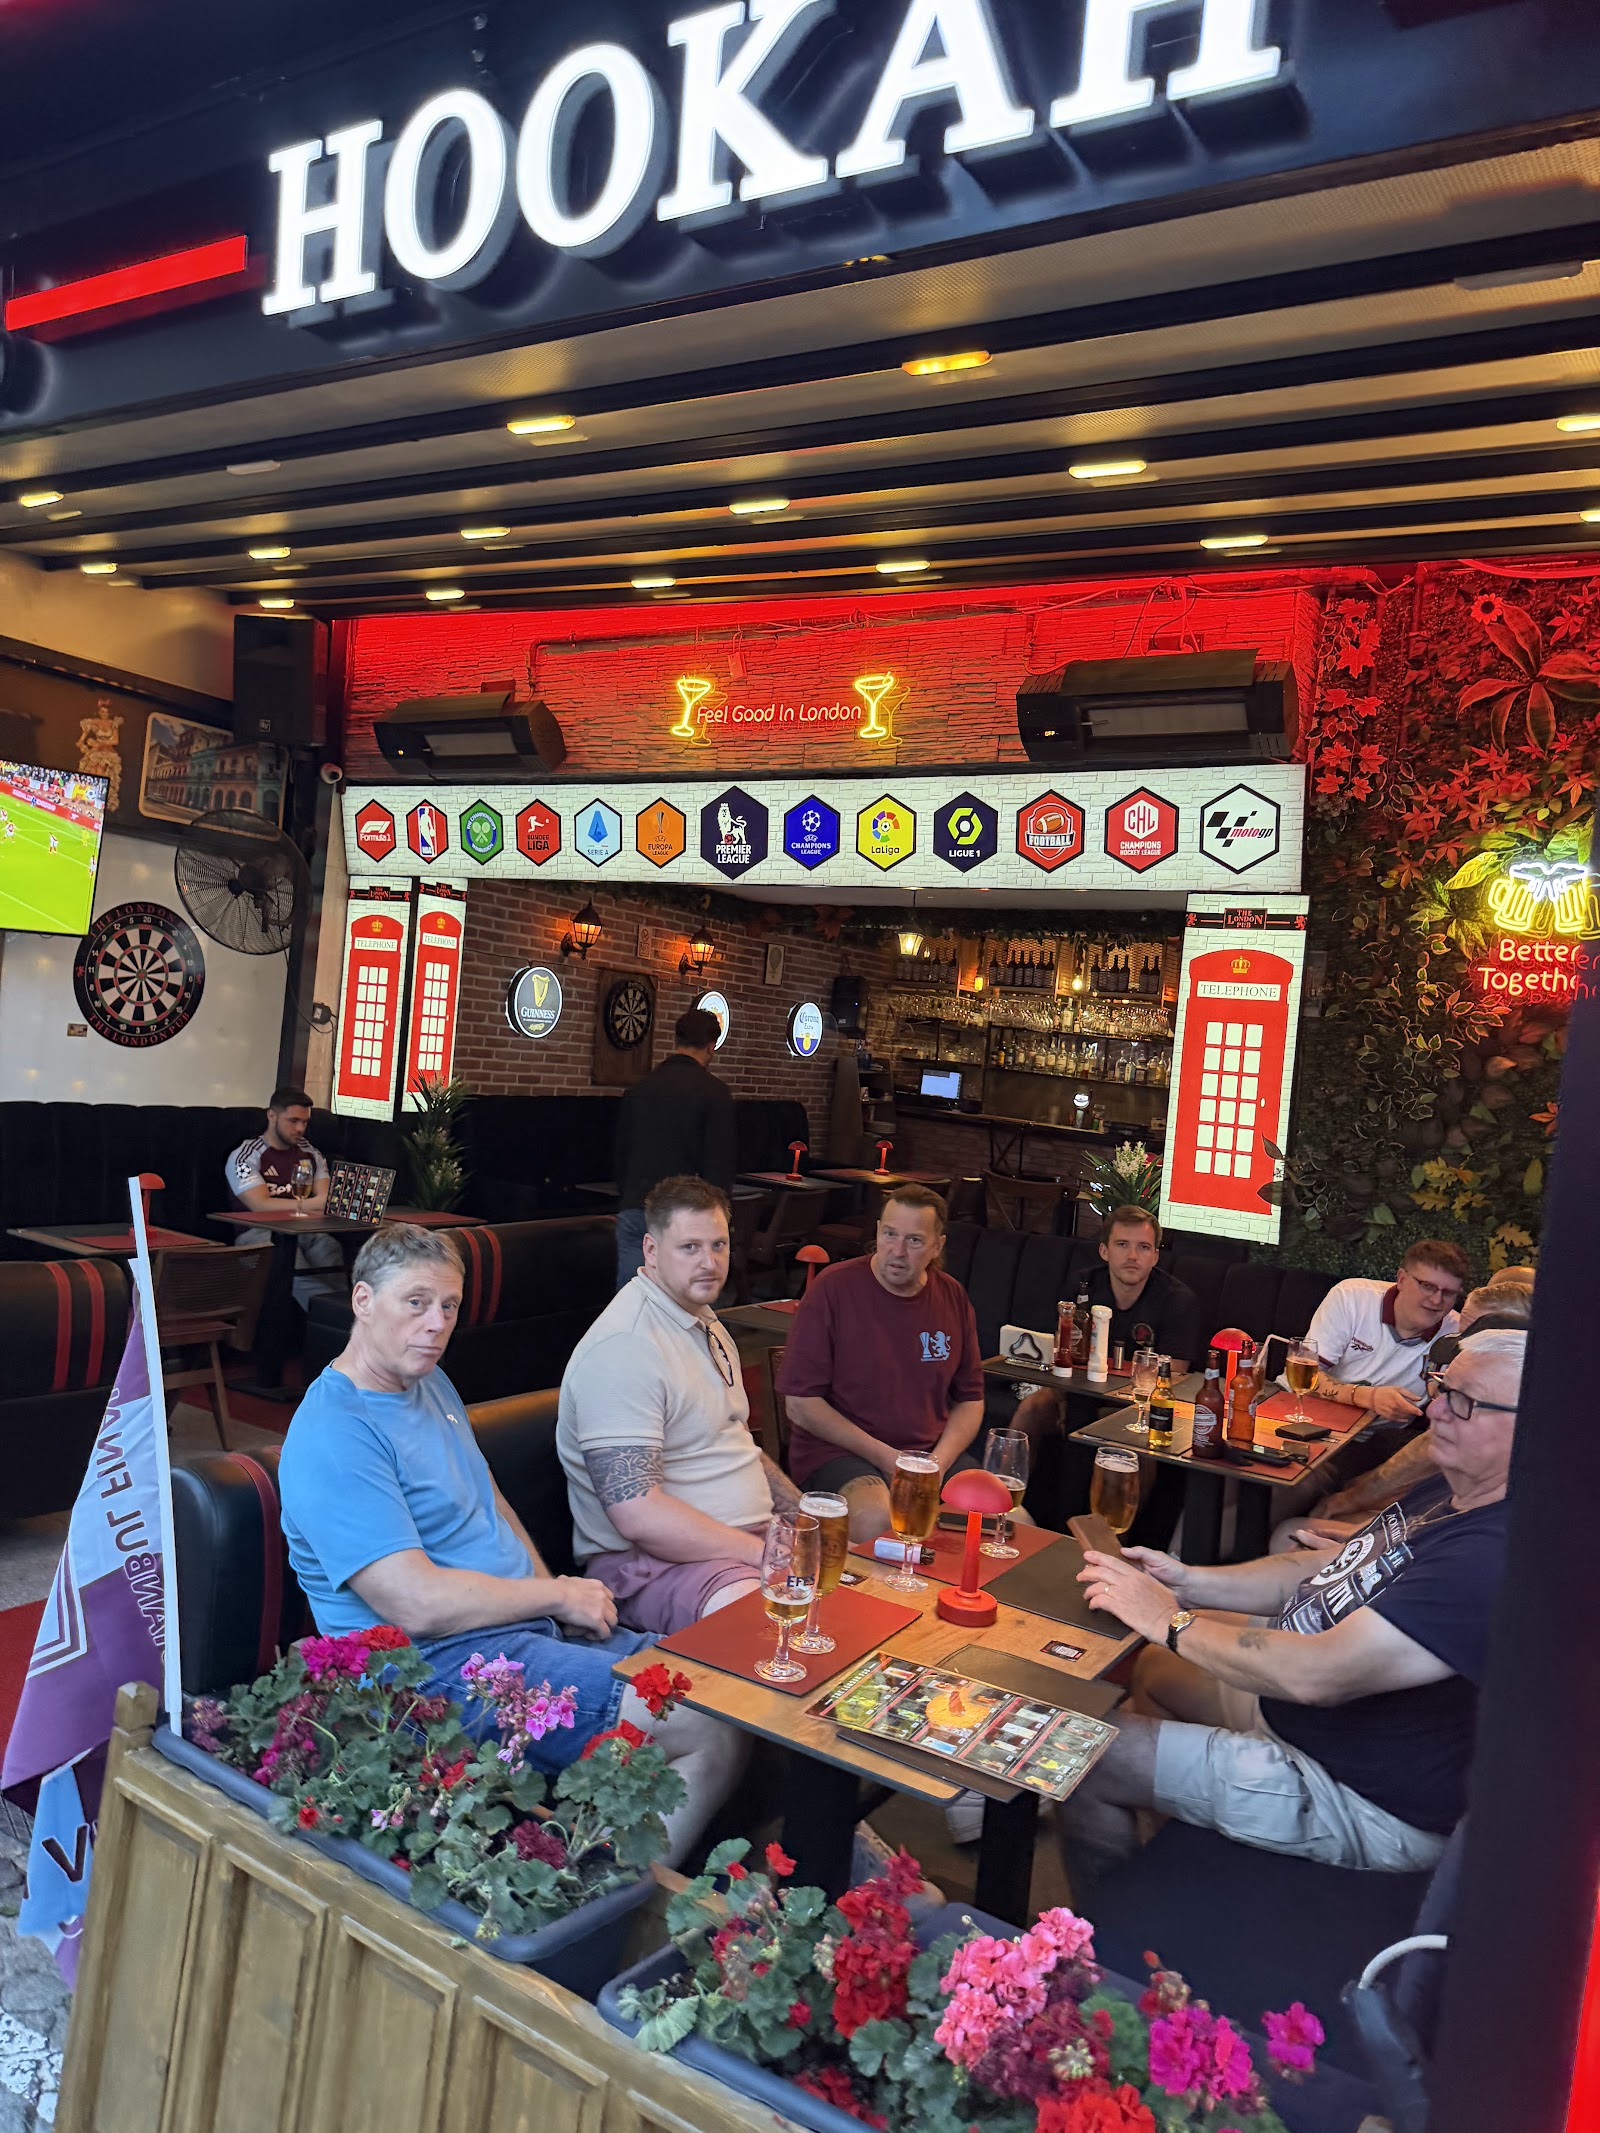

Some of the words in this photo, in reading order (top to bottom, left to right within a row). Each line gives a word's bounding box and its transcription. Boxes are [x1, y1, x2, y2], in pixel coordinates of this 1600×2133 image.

[262, 0, 1282, 316] HOOKAH
[697, 704, 728, 724] Feel
[732, 703, 775, 723] Good
[779, 703, 794, 722] In
[799, 701, 861, 722] London
[1127, 805, 1156, 834] CHL
[1229, 827, 1274, 839] motogp
[527, 840, 550, 851] LIGA
[790, 842, 832, 850] CHAMPIONS
[1028, 834, 1072, 847] FOOTBALL
[1120, 841, 1162, 849] CHAMPIONS
[648, 843, 673, 851] EUROPA
[715, 844, 752, 854] PREMIER
[871, 844, 900, 855] LaLiga
[976, 849, 981, 857] 1
[717, 854, 750, 864] LEAGUE
[1226, 914, 1264, 925] LONDON
[356, 939, 396, 949] TELEPHONE
[424, 934, 456, 947] TELEPHONE
[1499, 938, 1581, 962] Better
[1477, 967, 1578, 996] Togeth
[1200, 984, 1277, 998] TELEPHONE
[521, 1006, 556, 1019] GUINNESS
[112, 1029, 168, 1047] LONDON
